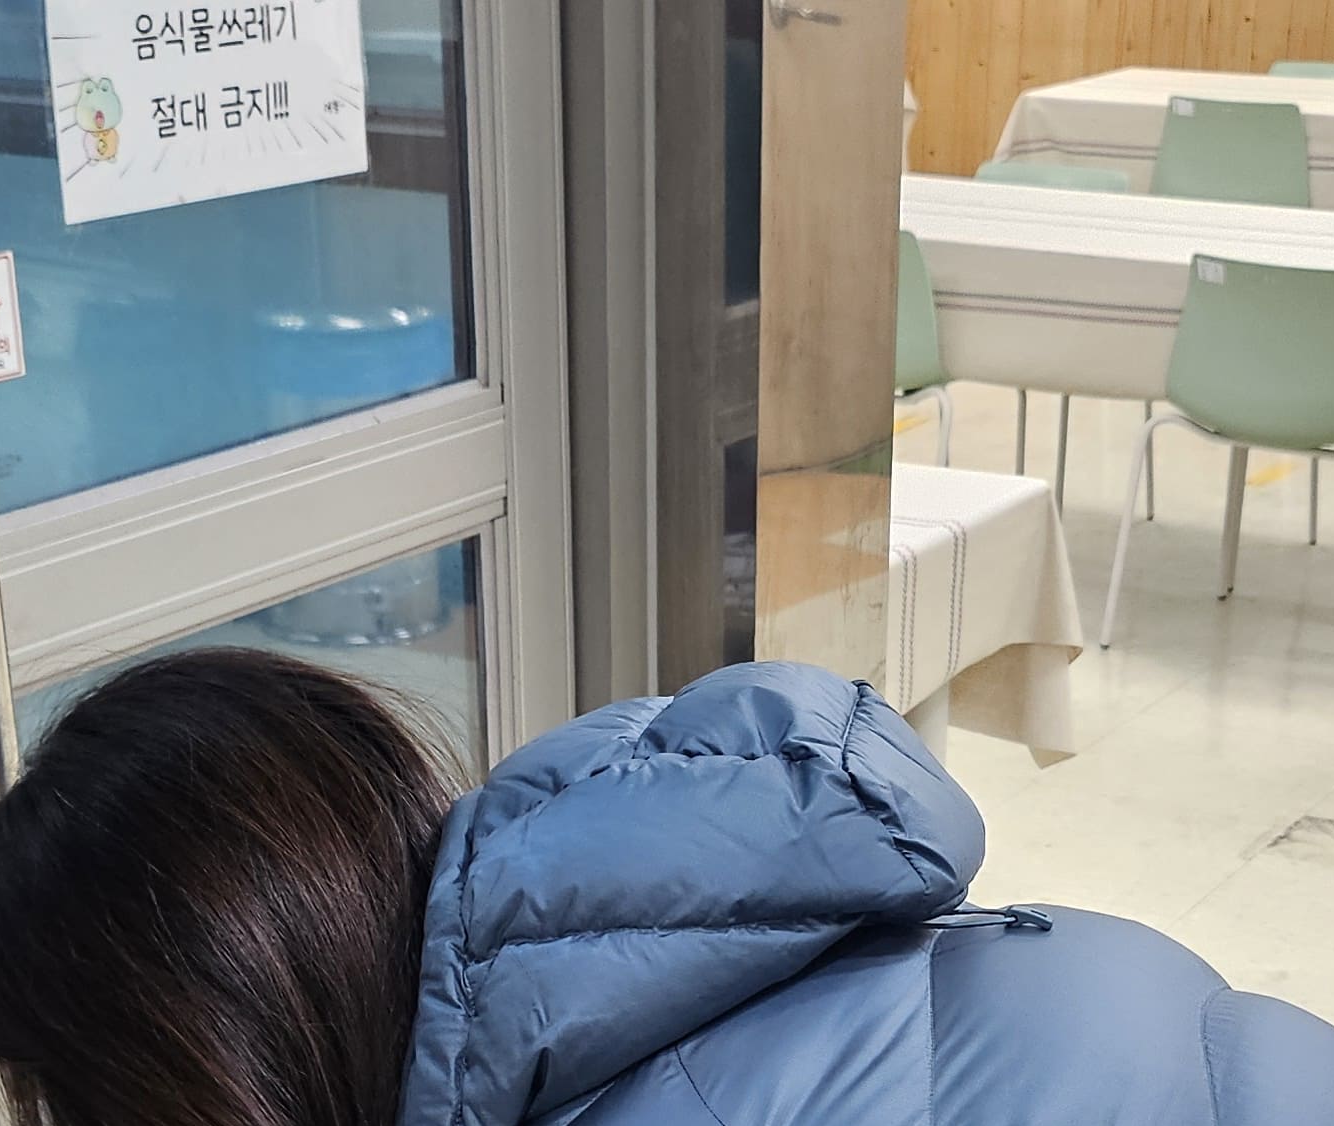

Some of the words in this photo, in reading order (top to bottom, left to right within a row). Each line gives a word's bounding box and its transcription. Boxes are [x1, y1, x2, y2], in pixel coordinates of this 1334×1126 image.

[131, 0, 298, 61] 음식물쓰레기
[152, 92, 207, 138] 절대
[220, 81, 290, 130] 금지!!!
